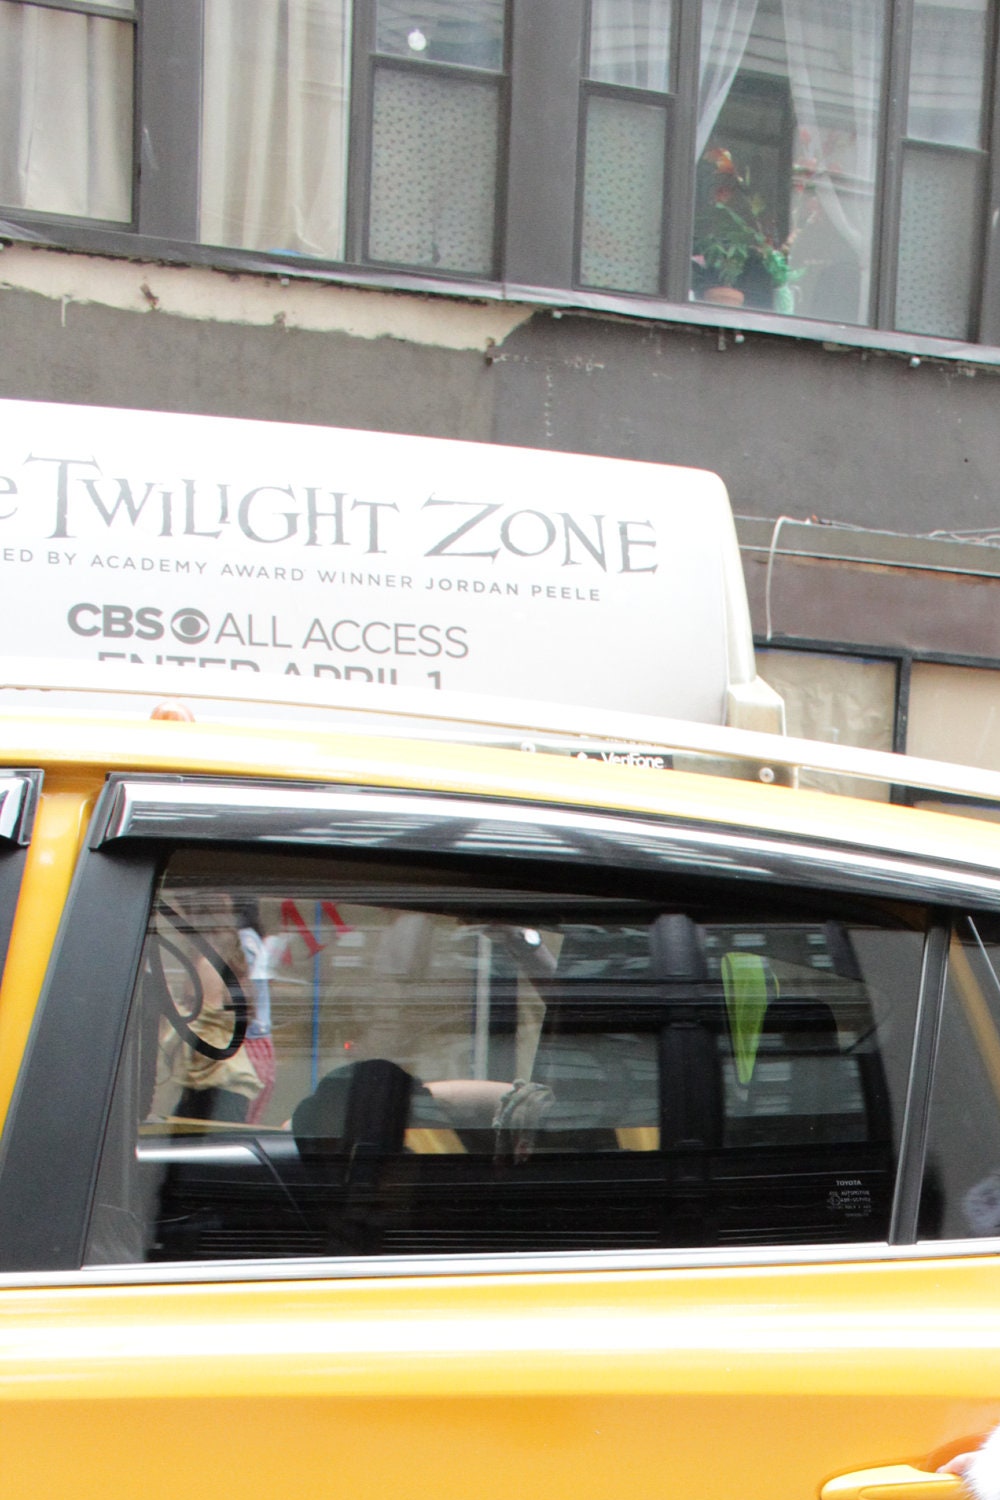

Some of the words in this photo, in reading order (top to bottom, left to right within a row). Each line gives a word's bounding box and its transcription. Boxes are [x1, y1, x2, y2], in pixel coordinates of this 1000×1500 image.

[22, 452, 400, 555] TWILIGHT
[420, 492, 659, 575] ZONE
[47, 551, 77, 566] BY
[90, 554, 208, 575] ACADEMY
[221, 563, 304, 582] AWARD
[317, 570, 413, 589] WINNER
[425, 577, 519, 596] JORDAN
[531, 584, 601, 602] PEELE
[67, 602, 166, 642] CBS
[214, 612, 293, 649] ALL
[302, 617, 469, 660] ACCESS
[600, 751, 664, 769] VeriFone
[836, 1179, 862, 1187] TOYOTA
